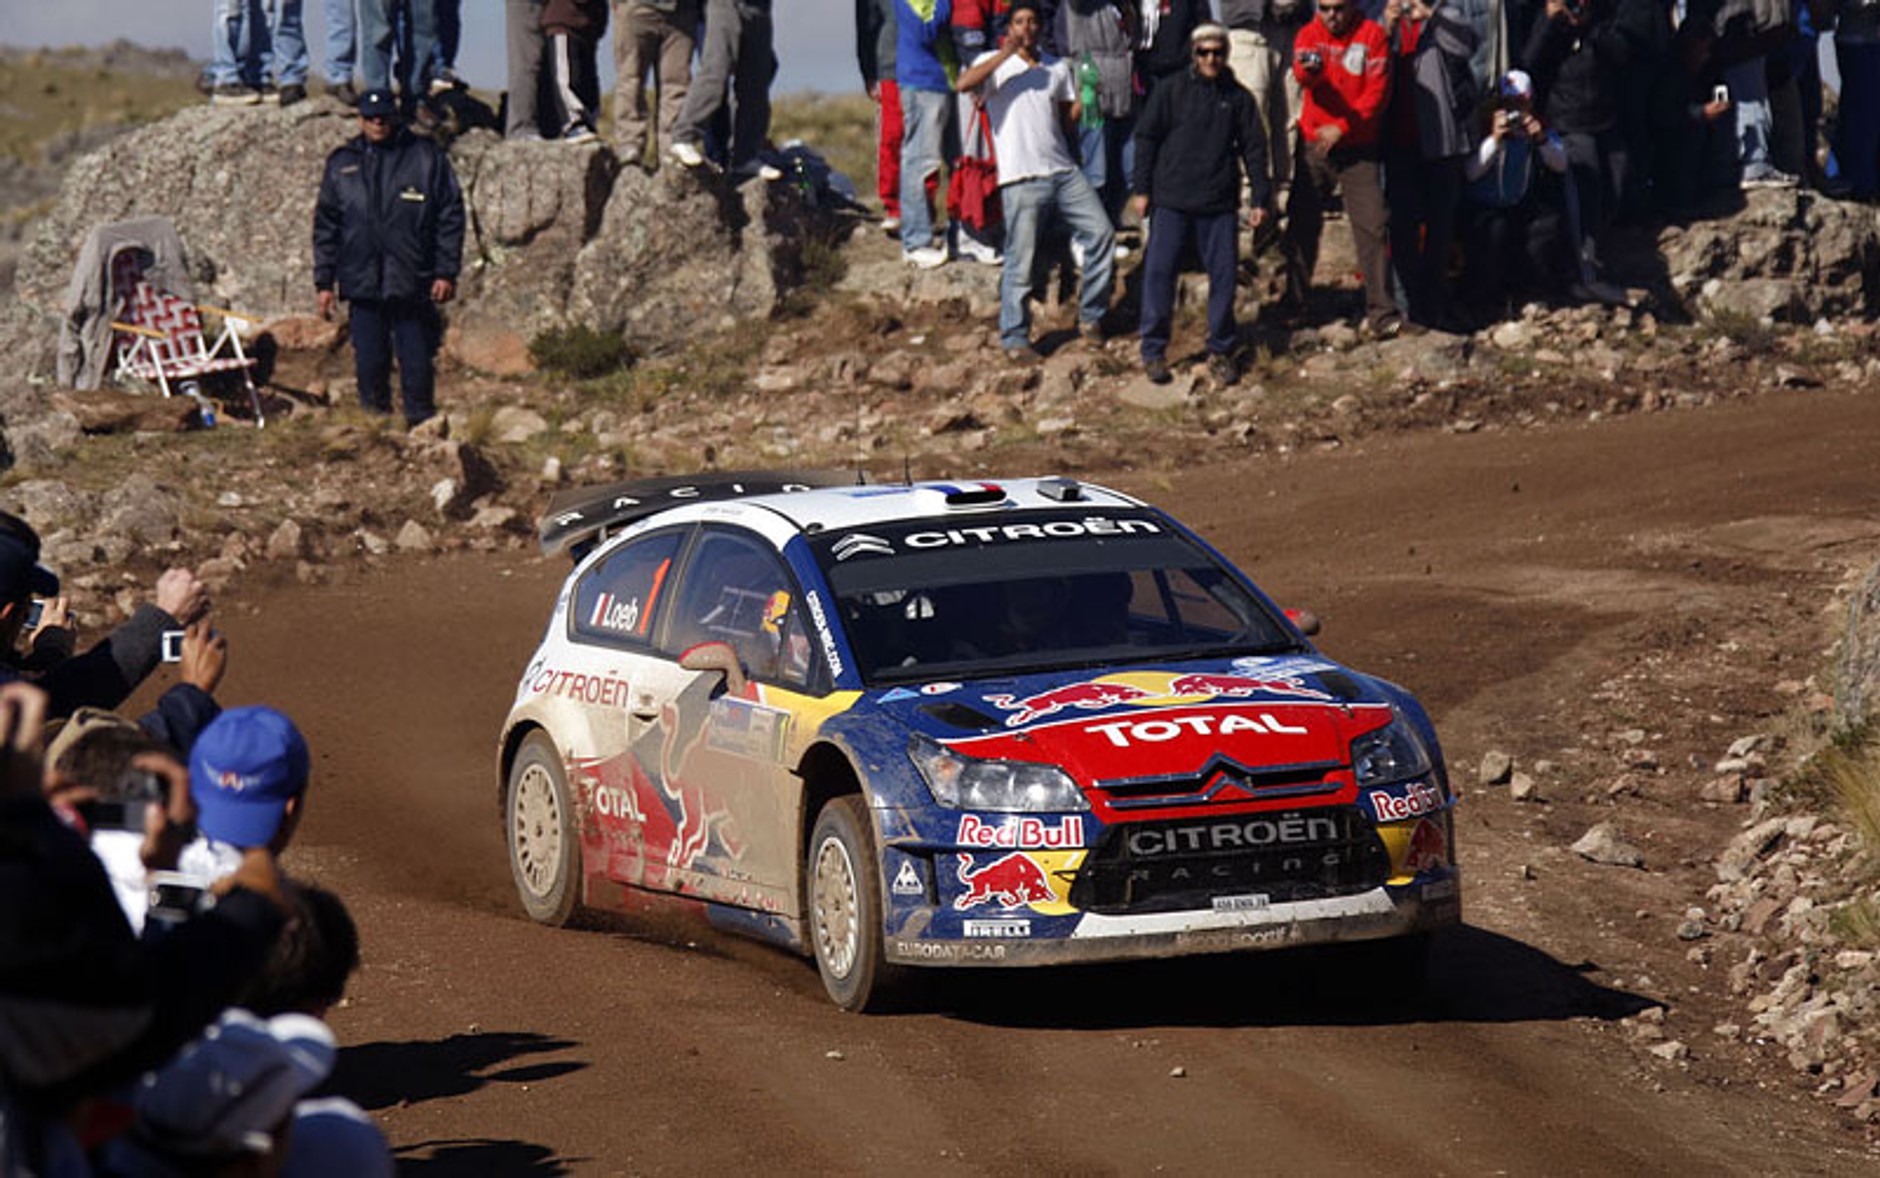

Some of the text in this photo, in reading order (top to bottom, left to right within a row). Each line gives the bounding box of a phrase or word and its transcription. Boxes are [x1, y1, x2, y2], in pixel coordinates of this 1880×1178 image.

[601, 593, 639, 632] Loeb
[1084, 713, 1309, 748] TOTAL
[957, 815, 1083, 847] Red Bull
[963, 919, 1031, 938] PIRELLI
